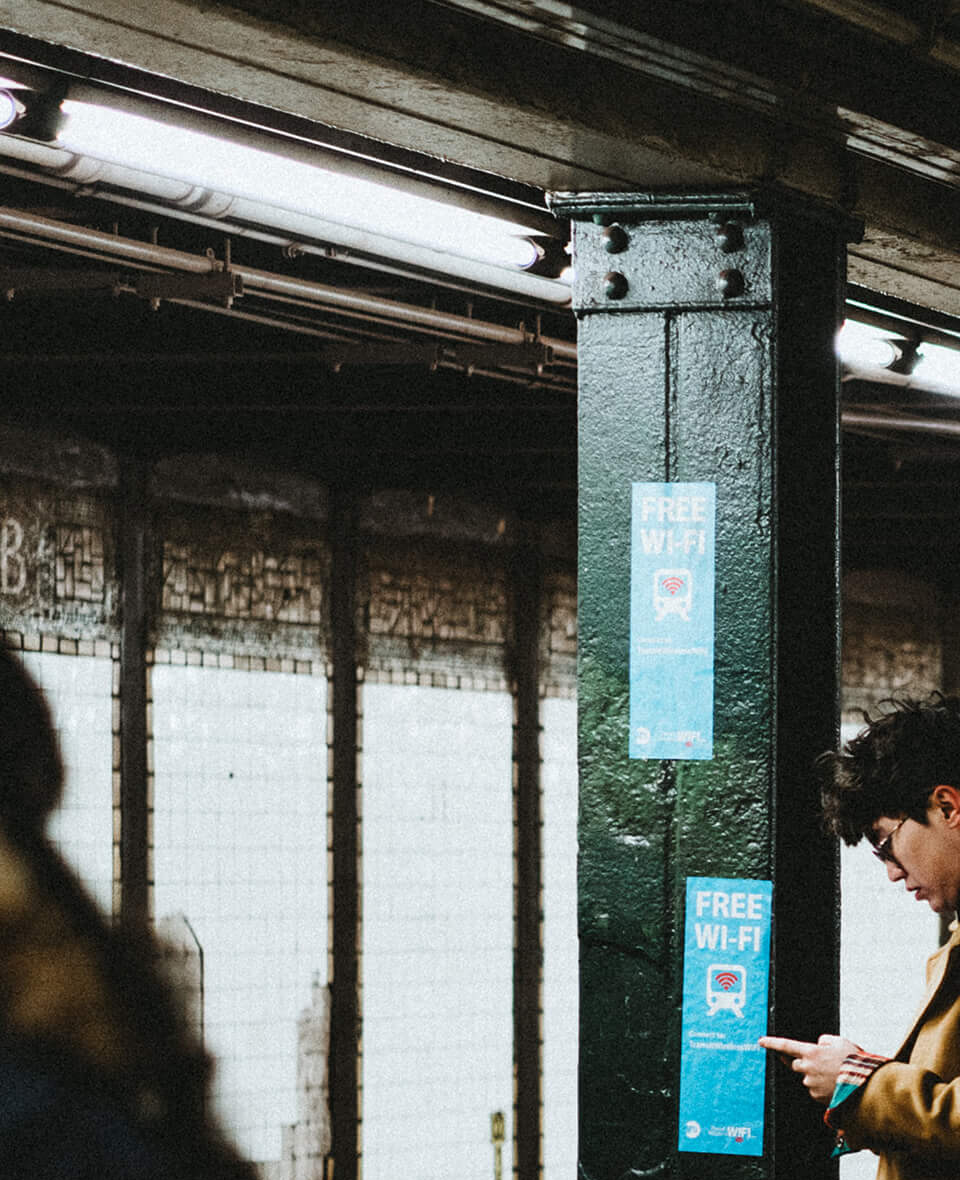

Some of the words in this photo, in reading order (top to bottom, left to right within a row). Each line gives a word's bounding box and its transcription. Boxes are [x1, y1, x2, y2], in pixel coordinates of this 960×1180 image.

[640, 496, 706, 522] FREE
[640, 528, 705, 555] WI-FI
[696, 891, 762, 920] FREE
[695, 923, 761, 952] WI-FI
